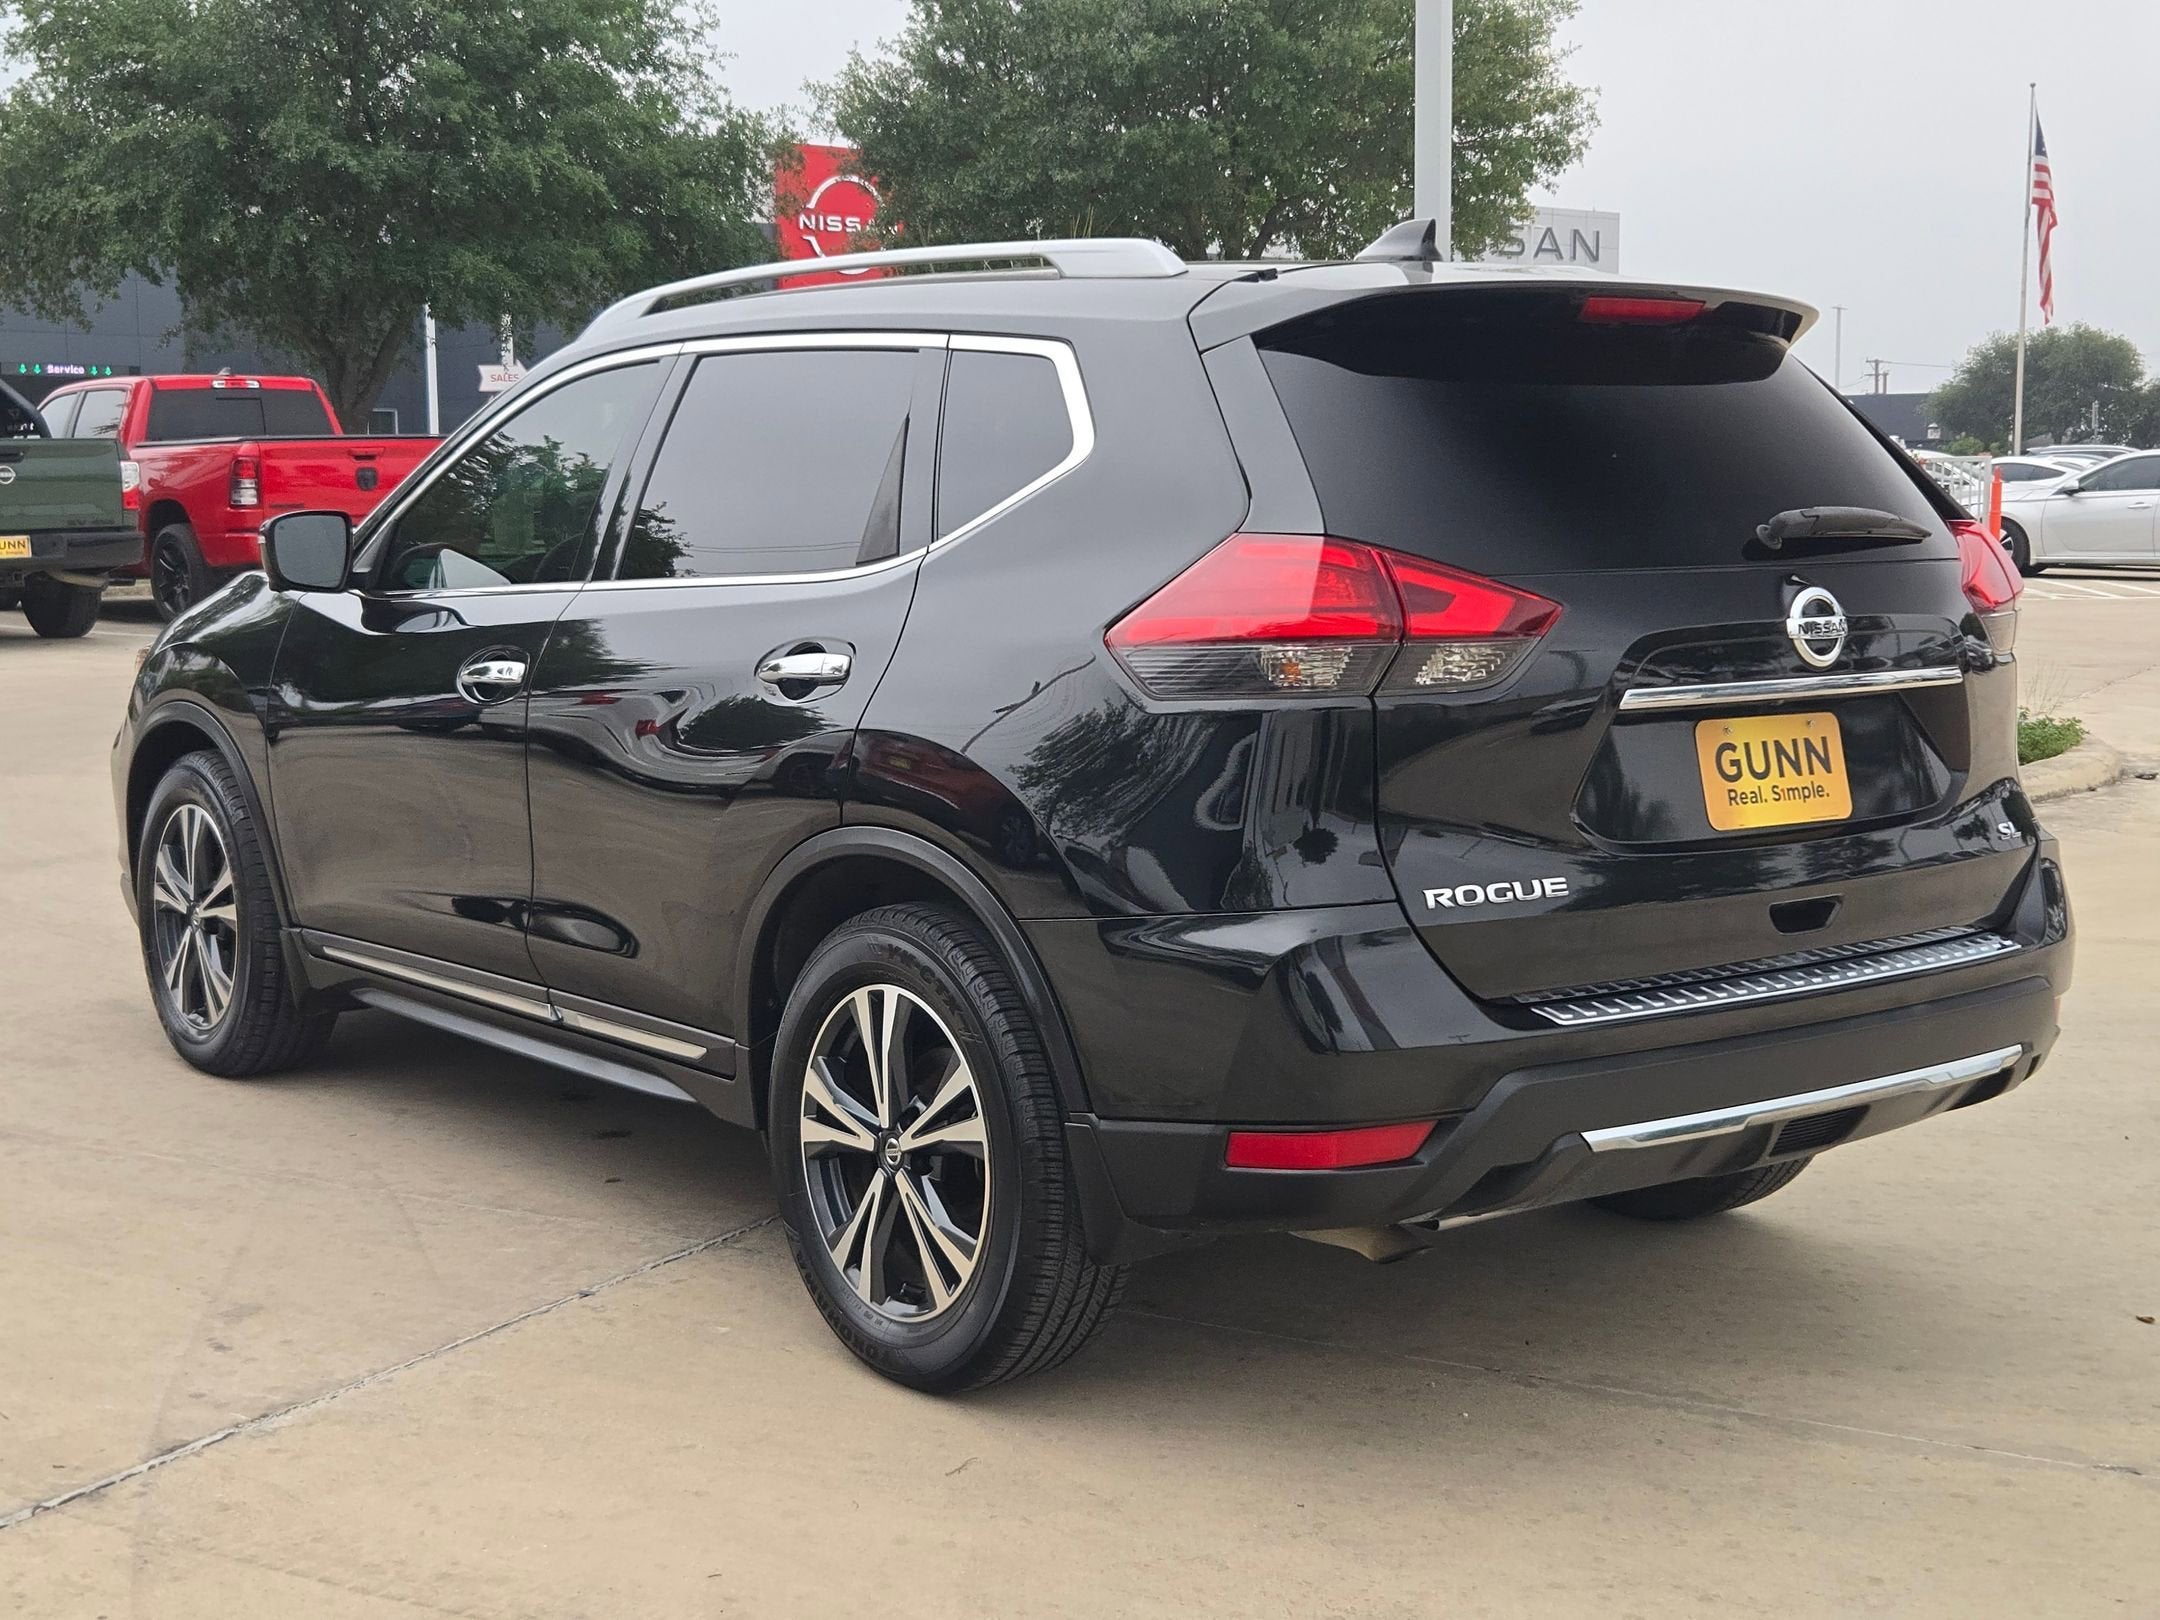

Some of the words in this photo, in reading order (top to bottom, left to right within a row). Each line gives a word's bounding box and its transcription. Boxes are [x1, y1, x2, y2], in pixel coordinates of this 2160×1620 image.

[47, 364, 85, 375] Service
[490, 374, 520, 383] SALES
[1797, 619, 1847, 636] NISSAN
[1715, 736, 1832, 783] GUNN
[1728, 786, 1768, 806] Real.
[1772, 782, 1830, 803] Simple.
[1998, 821, 2022, 840] SL
[1423, 877, 1569, 909] ROGUE
